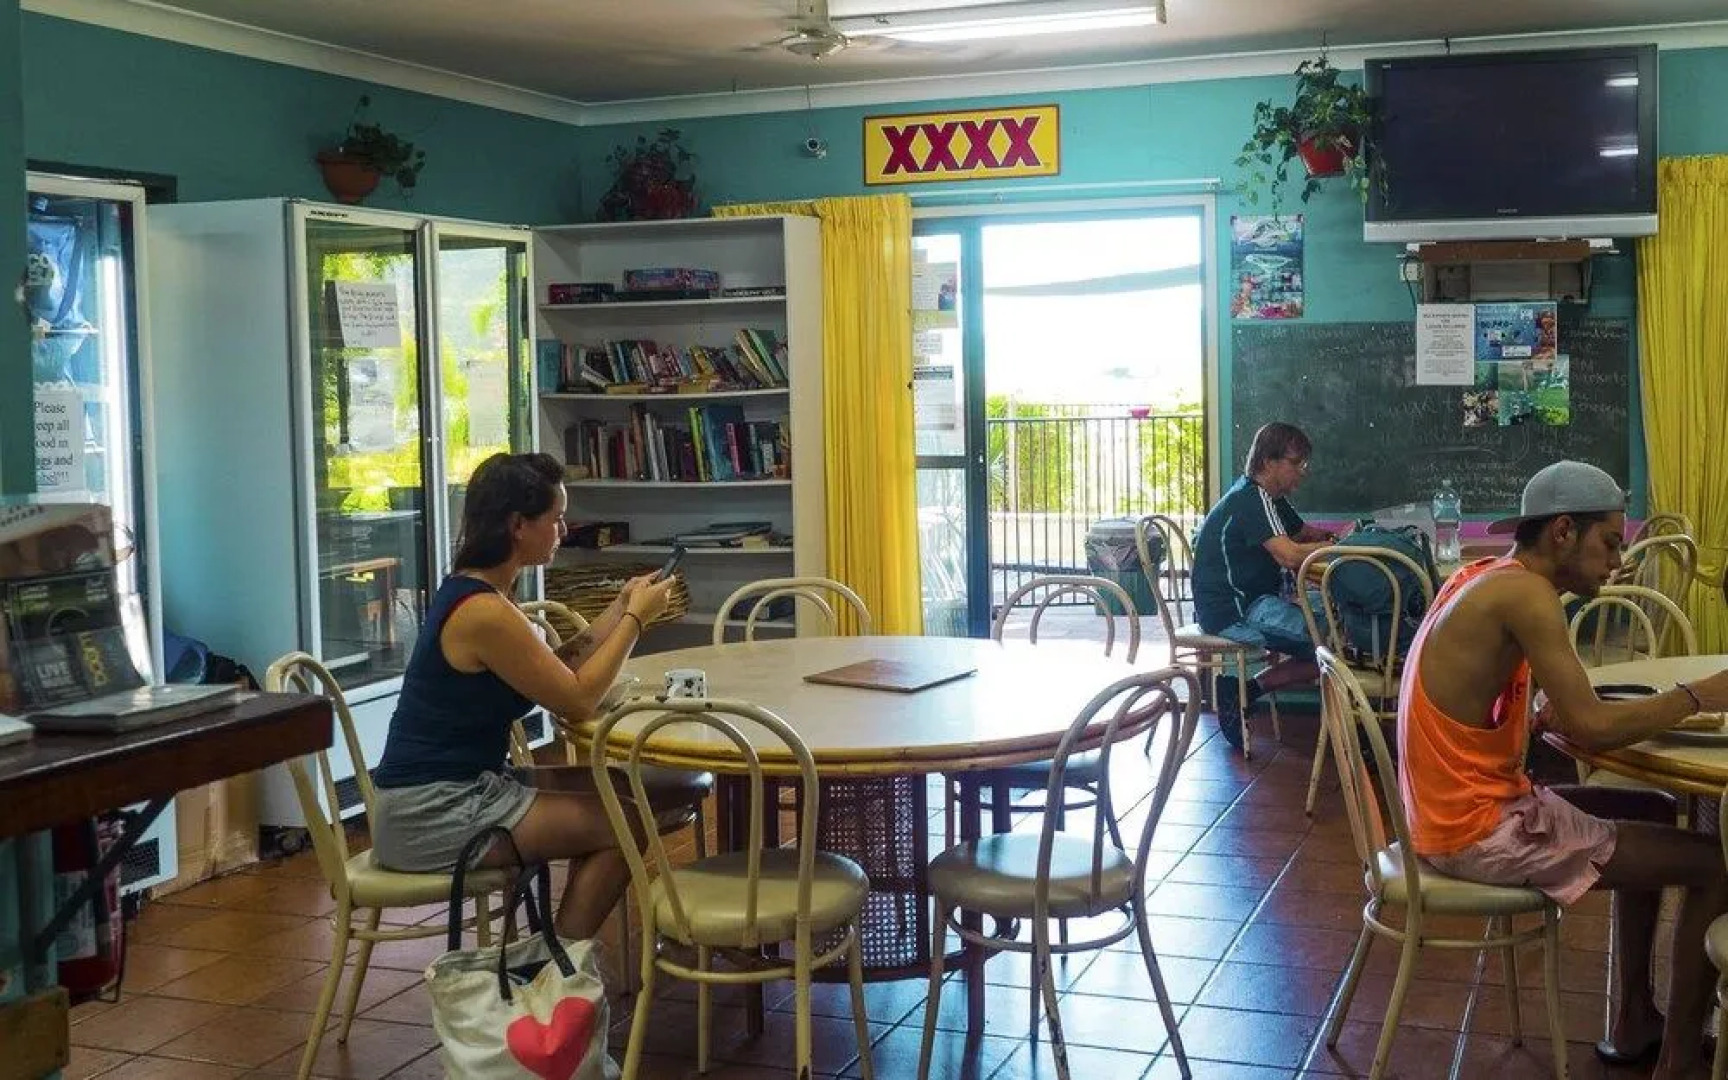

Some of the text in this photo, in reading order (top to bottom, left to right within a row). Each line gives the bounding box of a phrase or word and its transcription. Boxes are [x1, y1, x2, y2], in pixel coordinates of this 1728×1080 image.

[881, 116, 1041, 174] XXXX
[34, 401, 66, 413] Please
[36, 419, 70, 433] eep all
[36, 438, 69, 448] ood in
[35, 453, 73, 469] ags and
